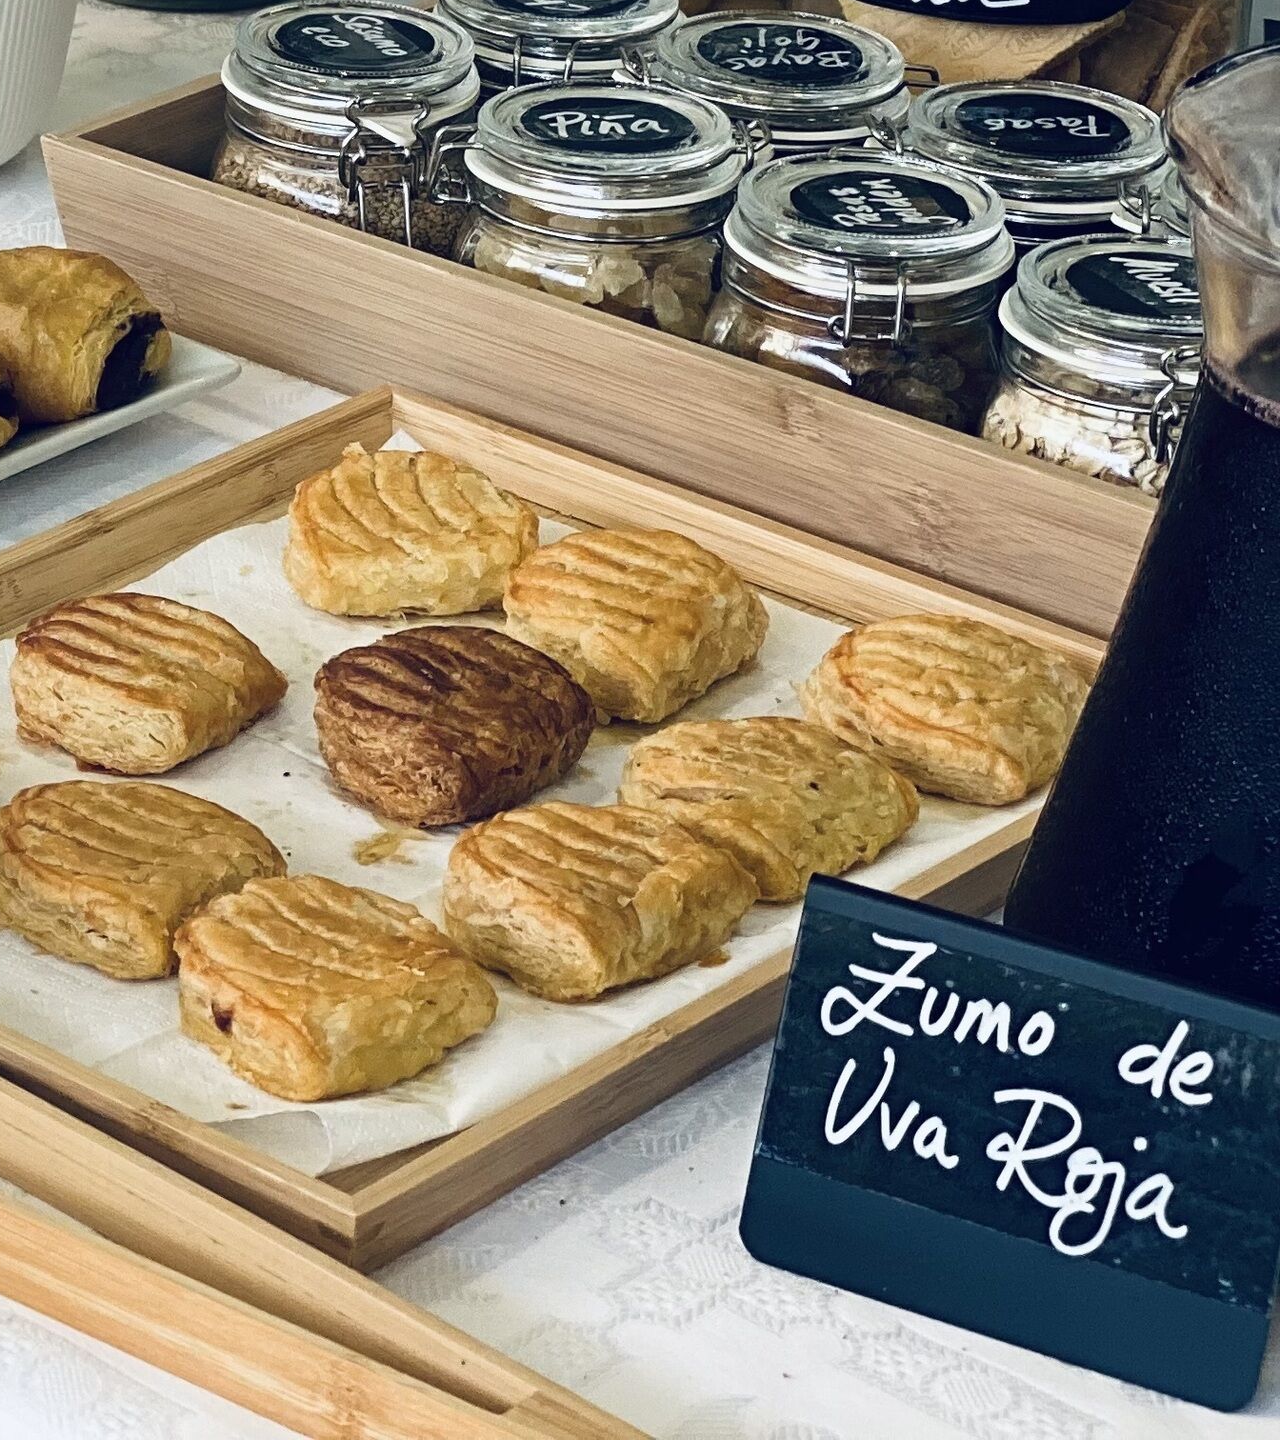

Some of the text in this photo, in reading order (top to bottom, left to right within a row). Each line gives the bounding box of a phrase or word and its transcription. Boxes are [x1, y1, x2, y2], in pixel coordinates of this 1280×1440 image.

[538, 111, 670, 138] Piña
[821, 932, 1214, 1106] Zumo de
[985, 1088, 1188, 1257] Roja
